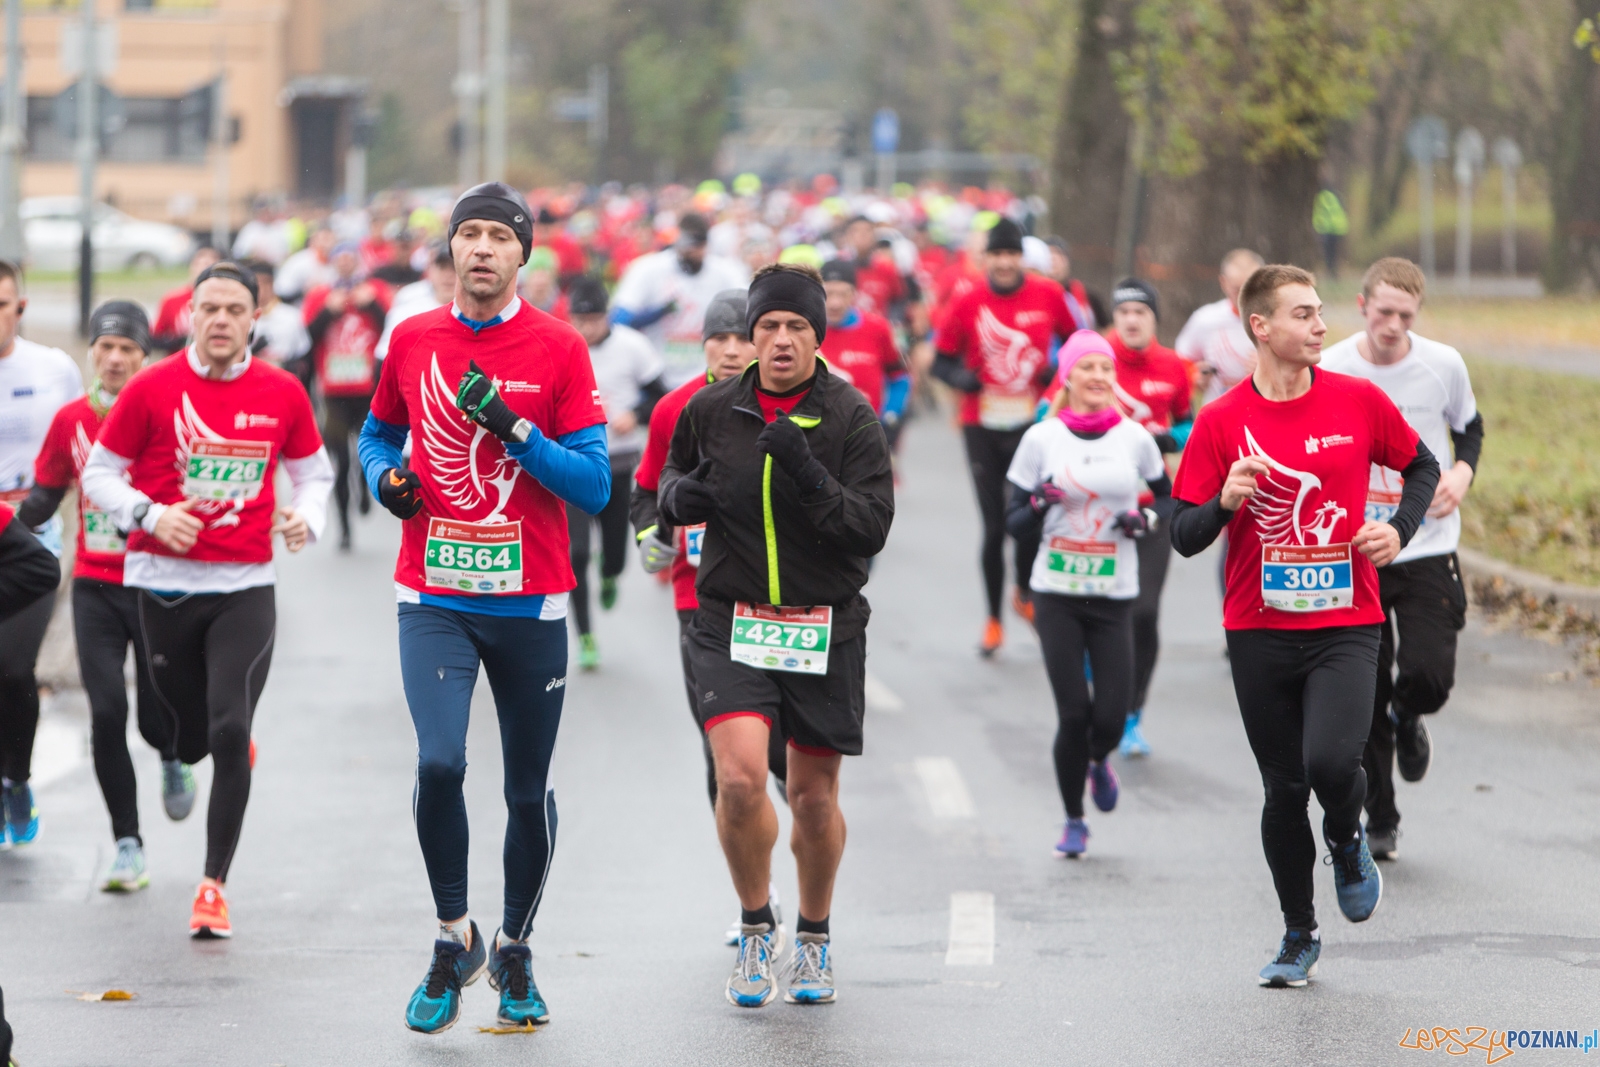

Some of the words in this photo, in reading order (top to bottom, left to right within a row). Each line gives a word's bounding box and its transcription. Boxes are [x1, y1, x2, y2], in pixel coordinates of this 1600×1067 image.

[197, 459, 259, 480] 2726
[476, 531, 515, 539] RunPoland.org
[428, 549, 436, 558] C
[438, 544, 512, 570] 8564
[1061, 554, 1106, 574] 797
[1283, 566, 1335, 589] 300
[735, 626, 744, 635] C
[745, 622, 819, 649] 4279
